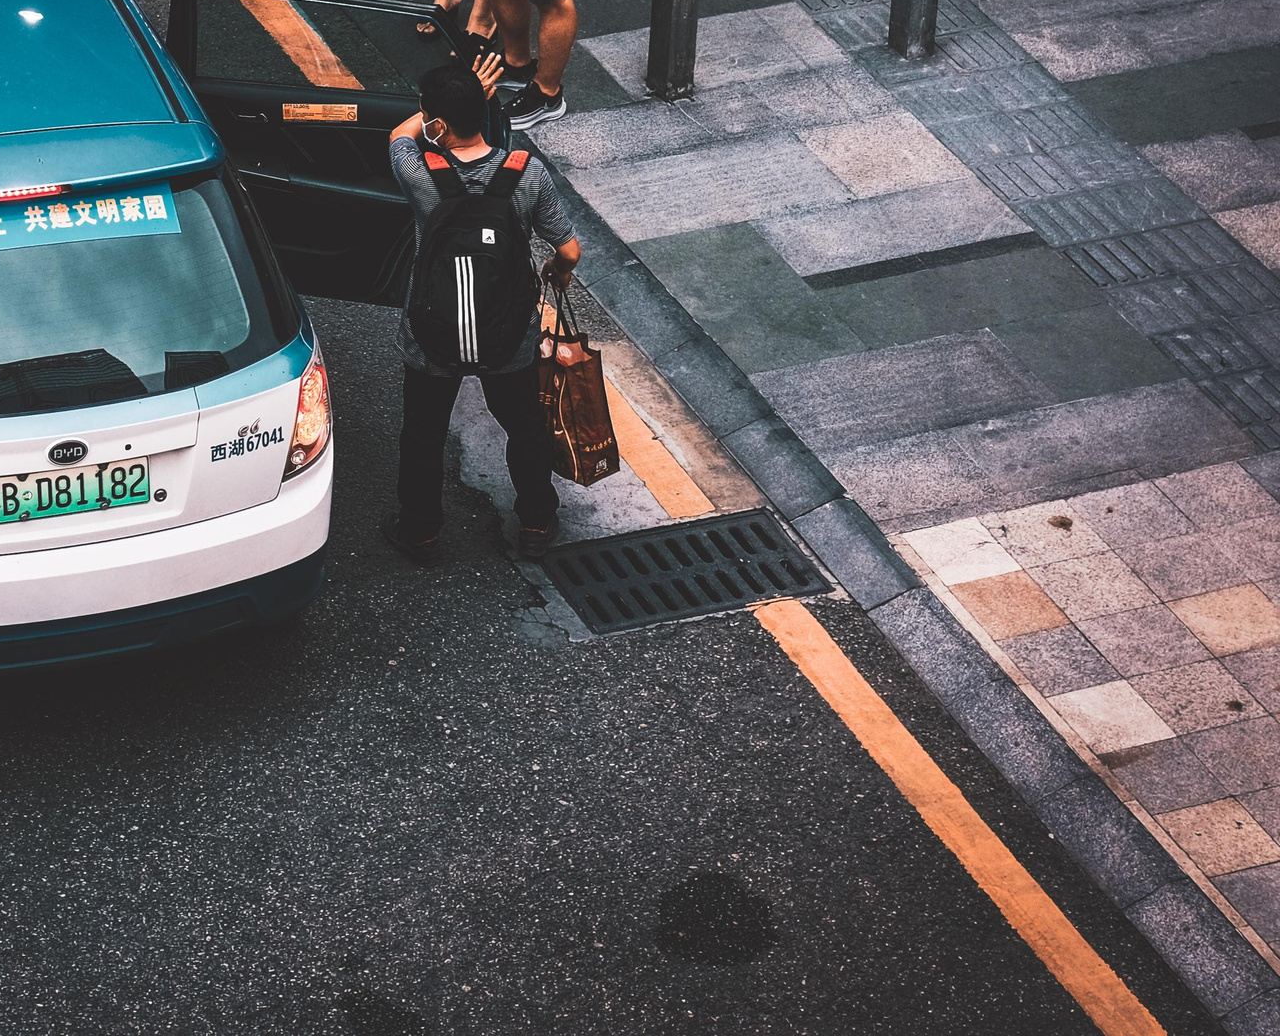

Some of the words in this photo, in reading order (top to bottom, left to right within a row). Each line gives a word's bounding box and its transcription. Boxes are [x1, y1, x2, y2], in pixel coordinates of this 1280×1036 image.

[24, 195, 167, 232] 共建文明家园
[238, 417, 261, 437] e6
[54, 446, 83, 459] BYD
